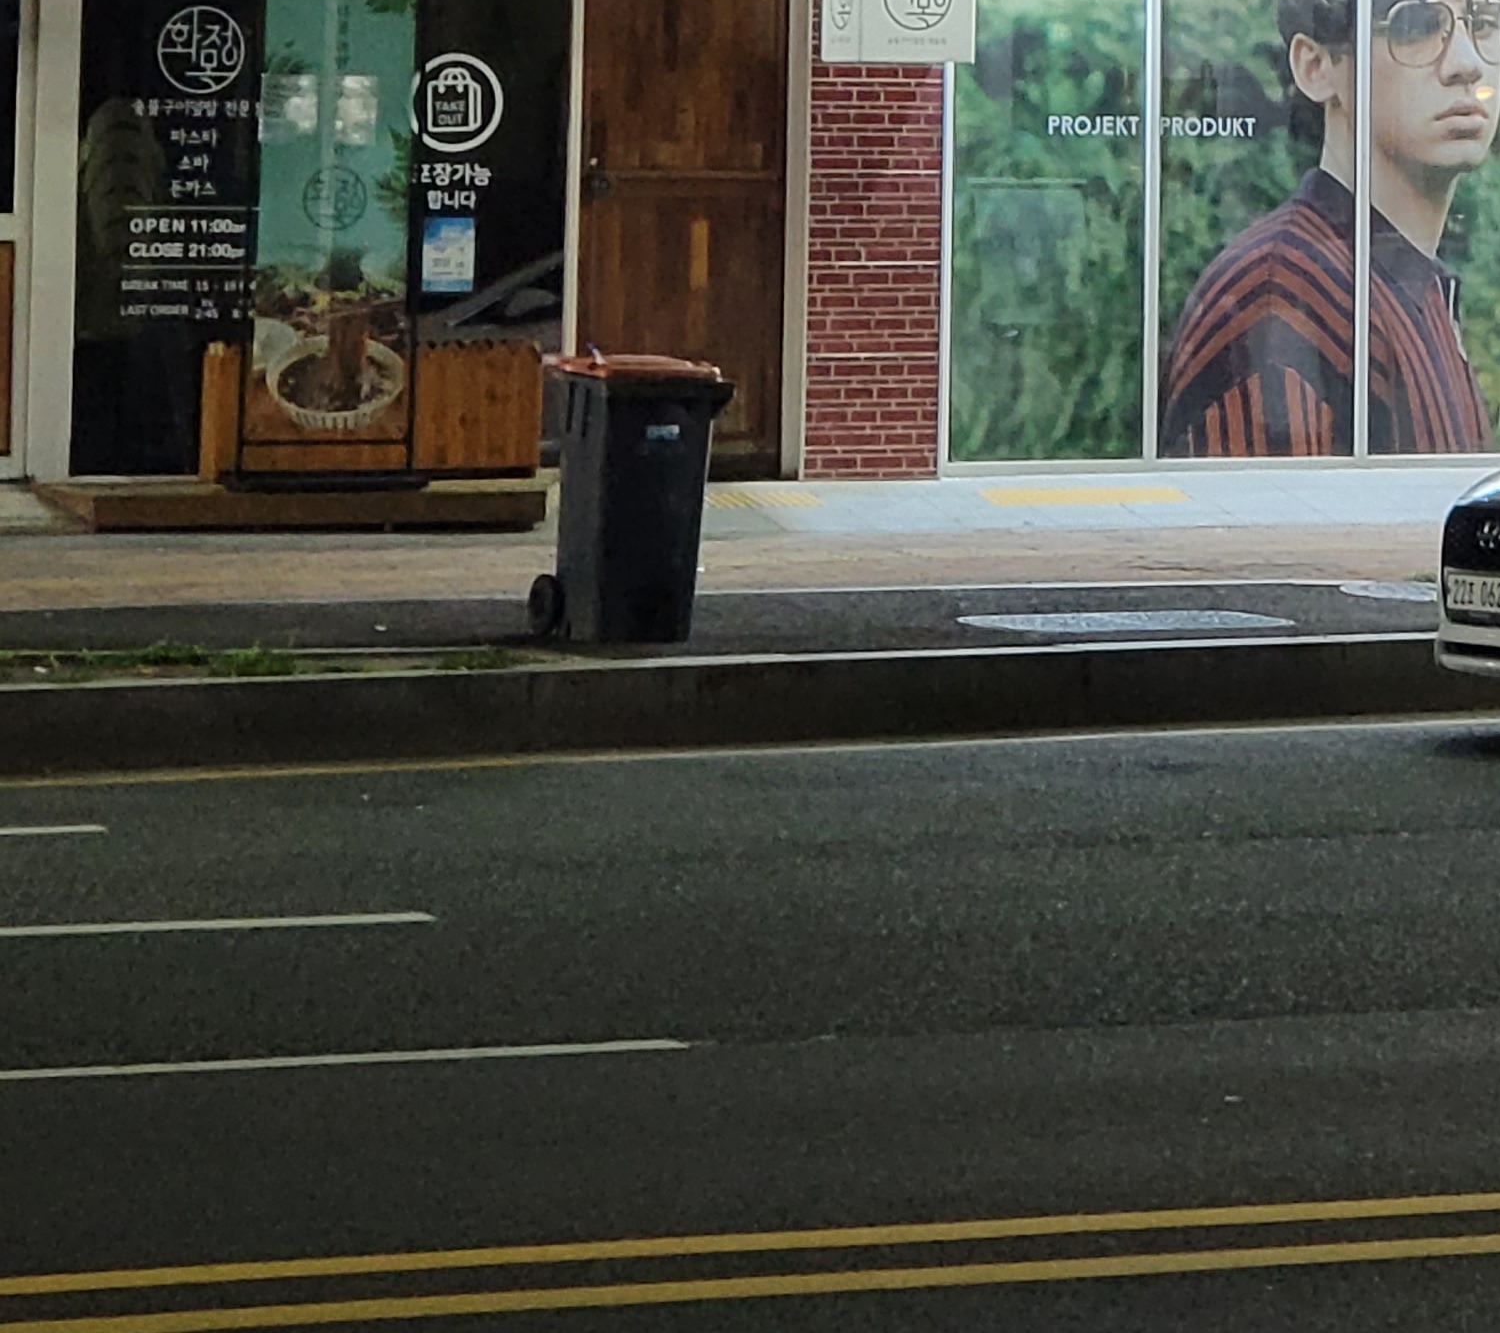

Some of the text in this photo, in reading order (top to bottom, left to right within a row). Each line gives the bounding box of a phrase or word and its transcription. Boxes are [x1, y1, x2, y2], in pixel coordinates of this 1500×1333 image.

[434, 99, 466, 113] TAKE
[437, 112, 464, 126] OUT
[1047, 115, 1257, 138] PROJEKT PRODUKT
[426, 189, 477, 210] 합니다
[129, 217, 186, 234] OPEN
[128, 242, 185, 258] CLOSE
